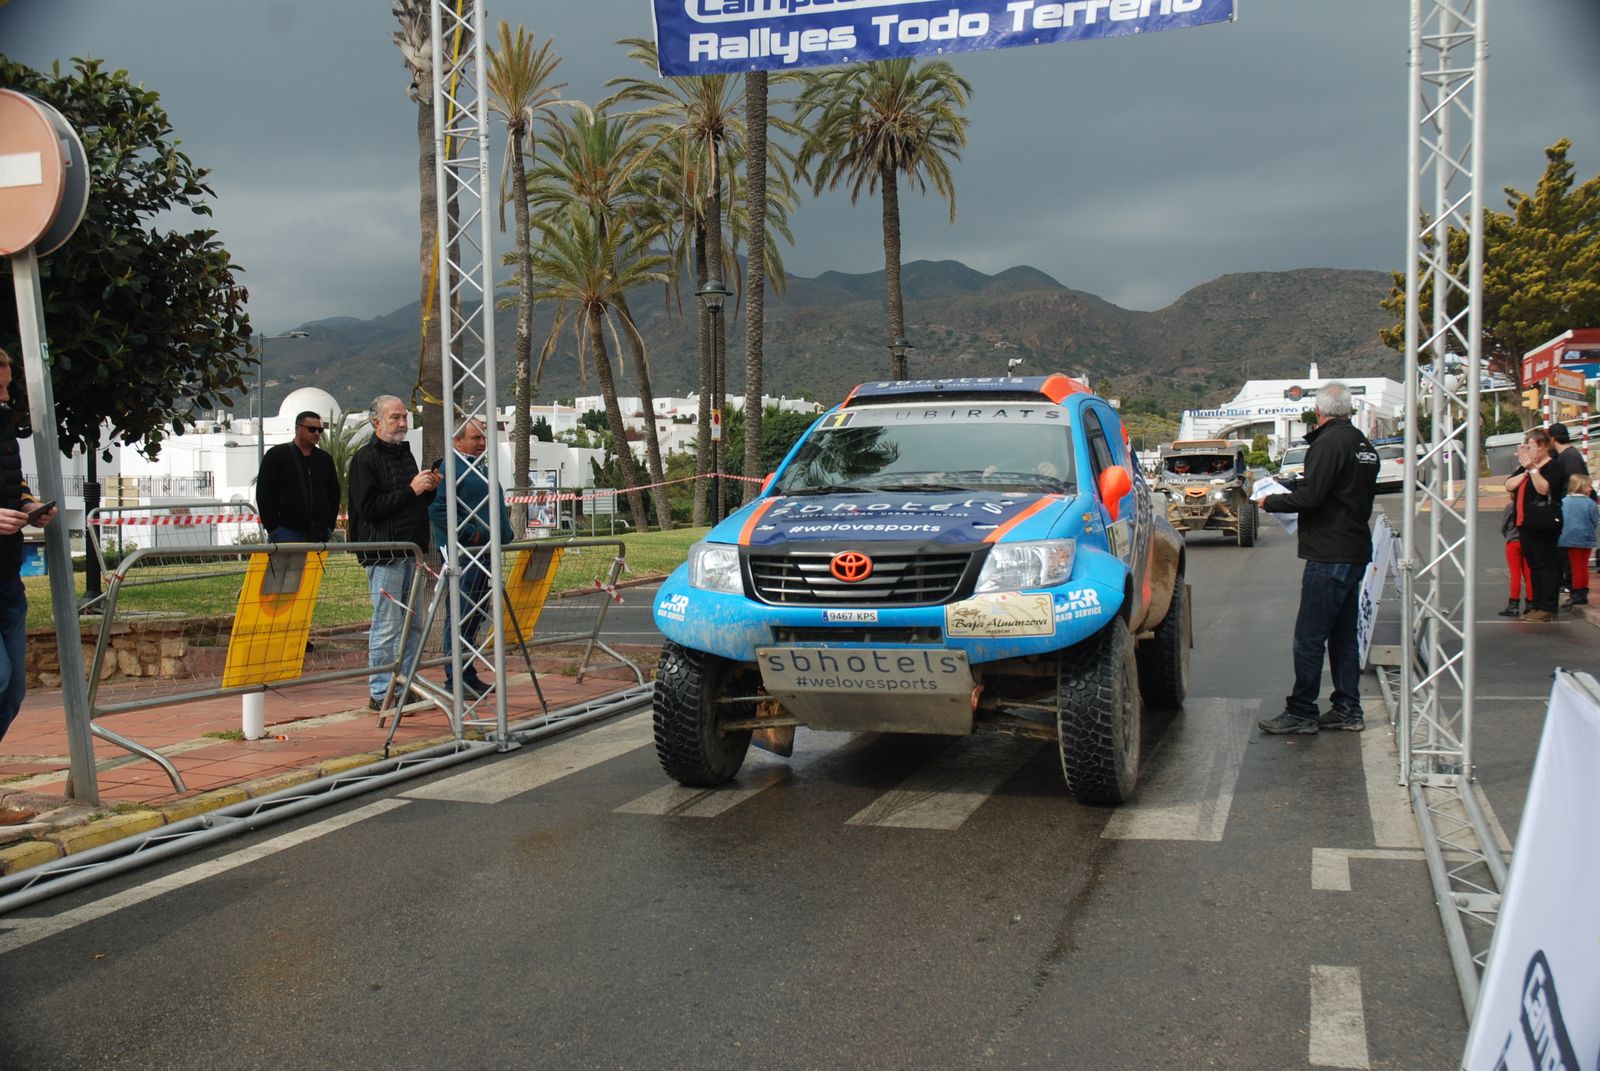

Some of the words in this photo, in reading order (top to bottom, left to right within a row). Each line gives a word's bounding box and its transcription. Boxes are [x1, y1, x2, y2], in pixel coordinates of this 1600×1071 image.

[689, 25, 857, 64] Rallyes
[872, 9, 990, 46] Todo
[1006, 0, 1201, 32] Terreno
[832, 413, 848, 428] 1
[789, 523, 941, 534] #welovesports
[1055, 588, 1100, 613] DKR
[829, 611, 853, 620] 9467
[857, 612, 876, 620] KPS
[1074, 606, 1102, 618] SERVICE
[954, 618, 984, 631] Baja
[768, 650, 957, 674] sbhotels
[796, 676, 938, 692] #welovesports
